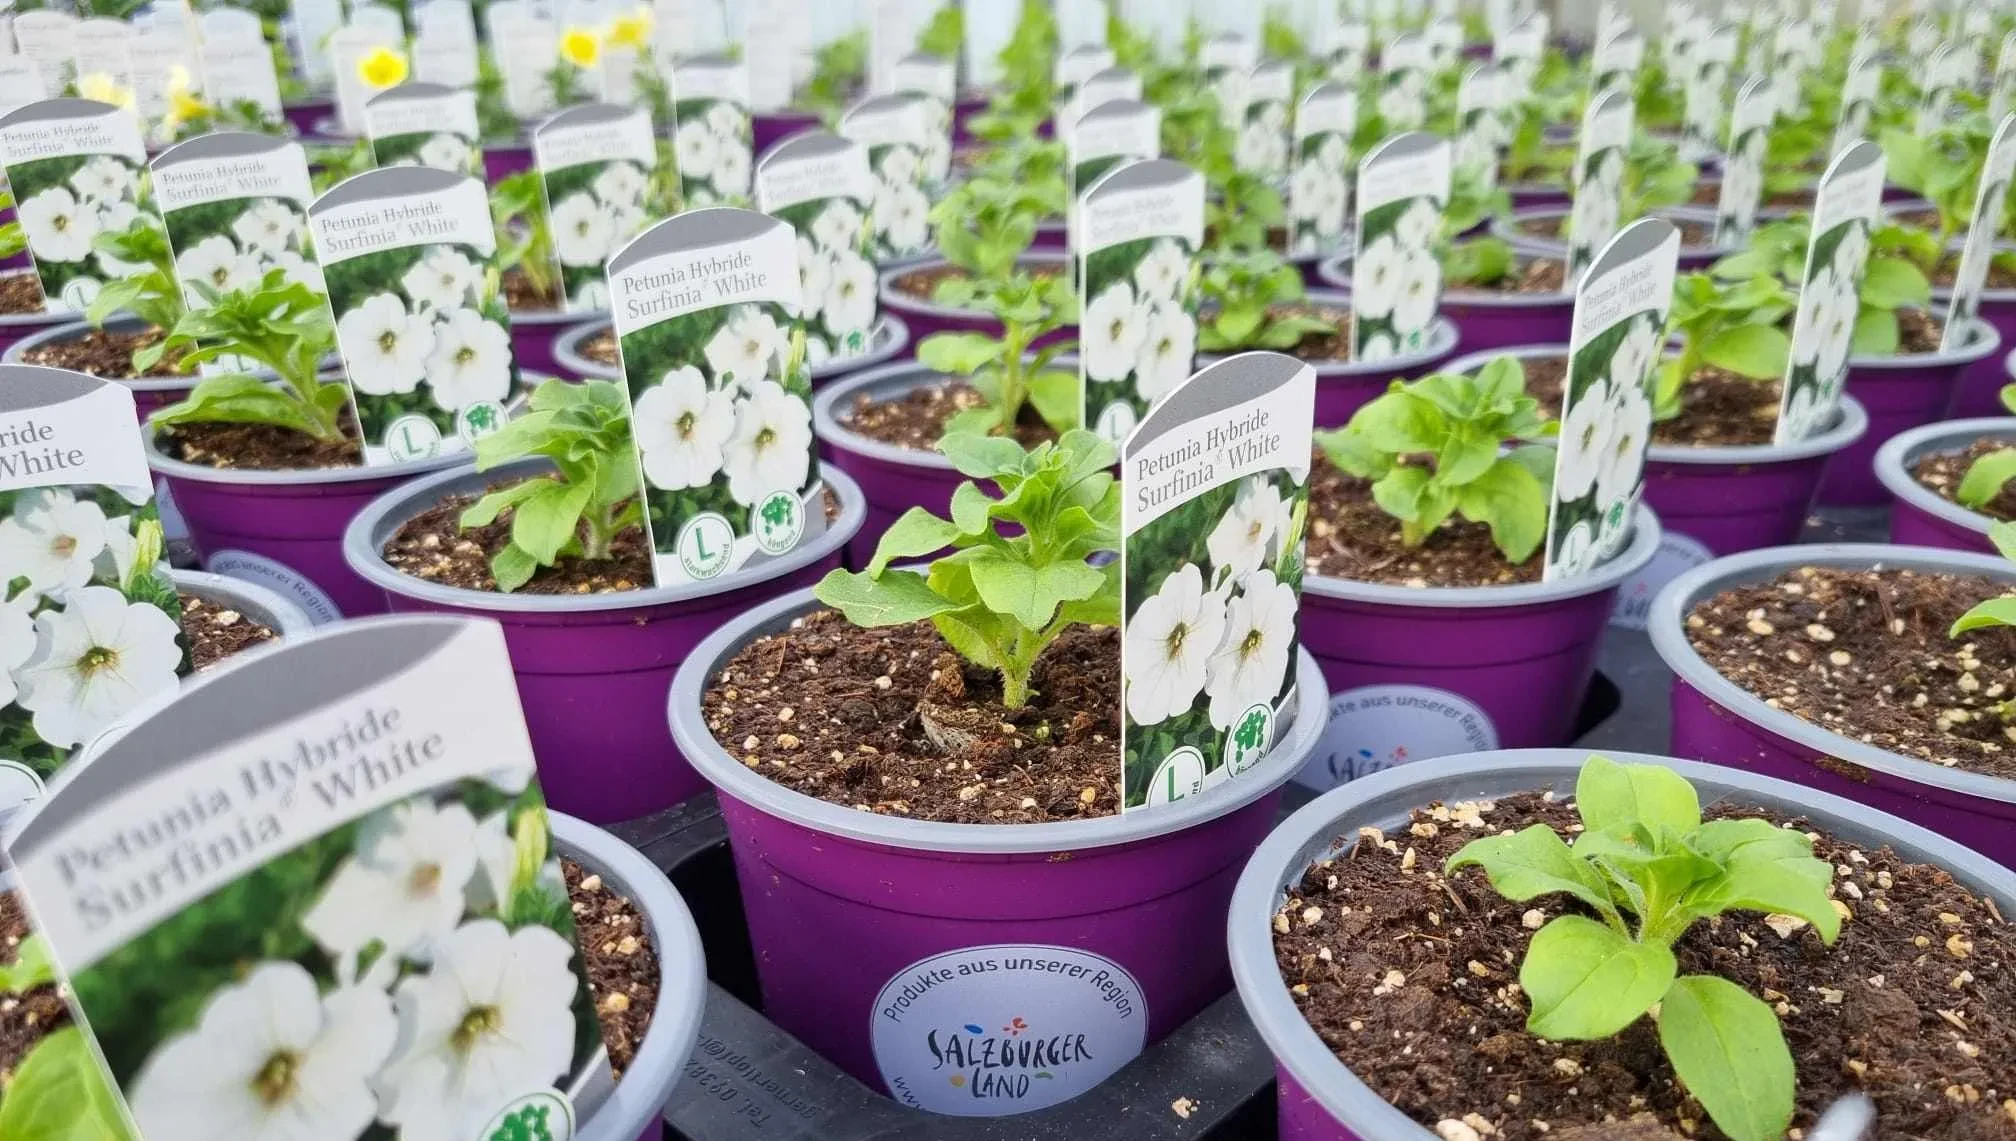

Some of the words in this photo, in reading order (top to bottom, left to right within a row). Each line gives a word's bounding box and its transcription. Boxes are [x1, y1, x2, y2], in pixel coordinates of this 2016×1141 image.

[321, 211, 380, 234] Petunia
[384, 200, 442, 223] Hybride
[408, 217, 460, 238] White
[623, 267, 686, 295] Petunia
[690, 250, 752, 280] Hybride
[713, 271, 768, 298] White
[0, 420, 55, 448] ride
[402, 426, 422, 456] L
[1137, 440, 1201, 483] Petunia
[1205, 407, 1270, 452] Hybride
[1227, 433, 1281, 471] White
[696, 527, 716, 561] L
[311, 731, 446, 809] White
[1168, 764, 1185, 803] L
[54, 784, 233, 888] Petunia
[239, 705, 402, 801] Hybride
[883, 968, 955, 1022] Produkte
[958, 959, 998, 976] aus
[1004, 958, 1093, 979] unserer
[1090, 969, 1133, 1019] Region
[927, 1028, 1093, 1070] SALZBURGER
[971, 1066, 1030, 1099] LAND
